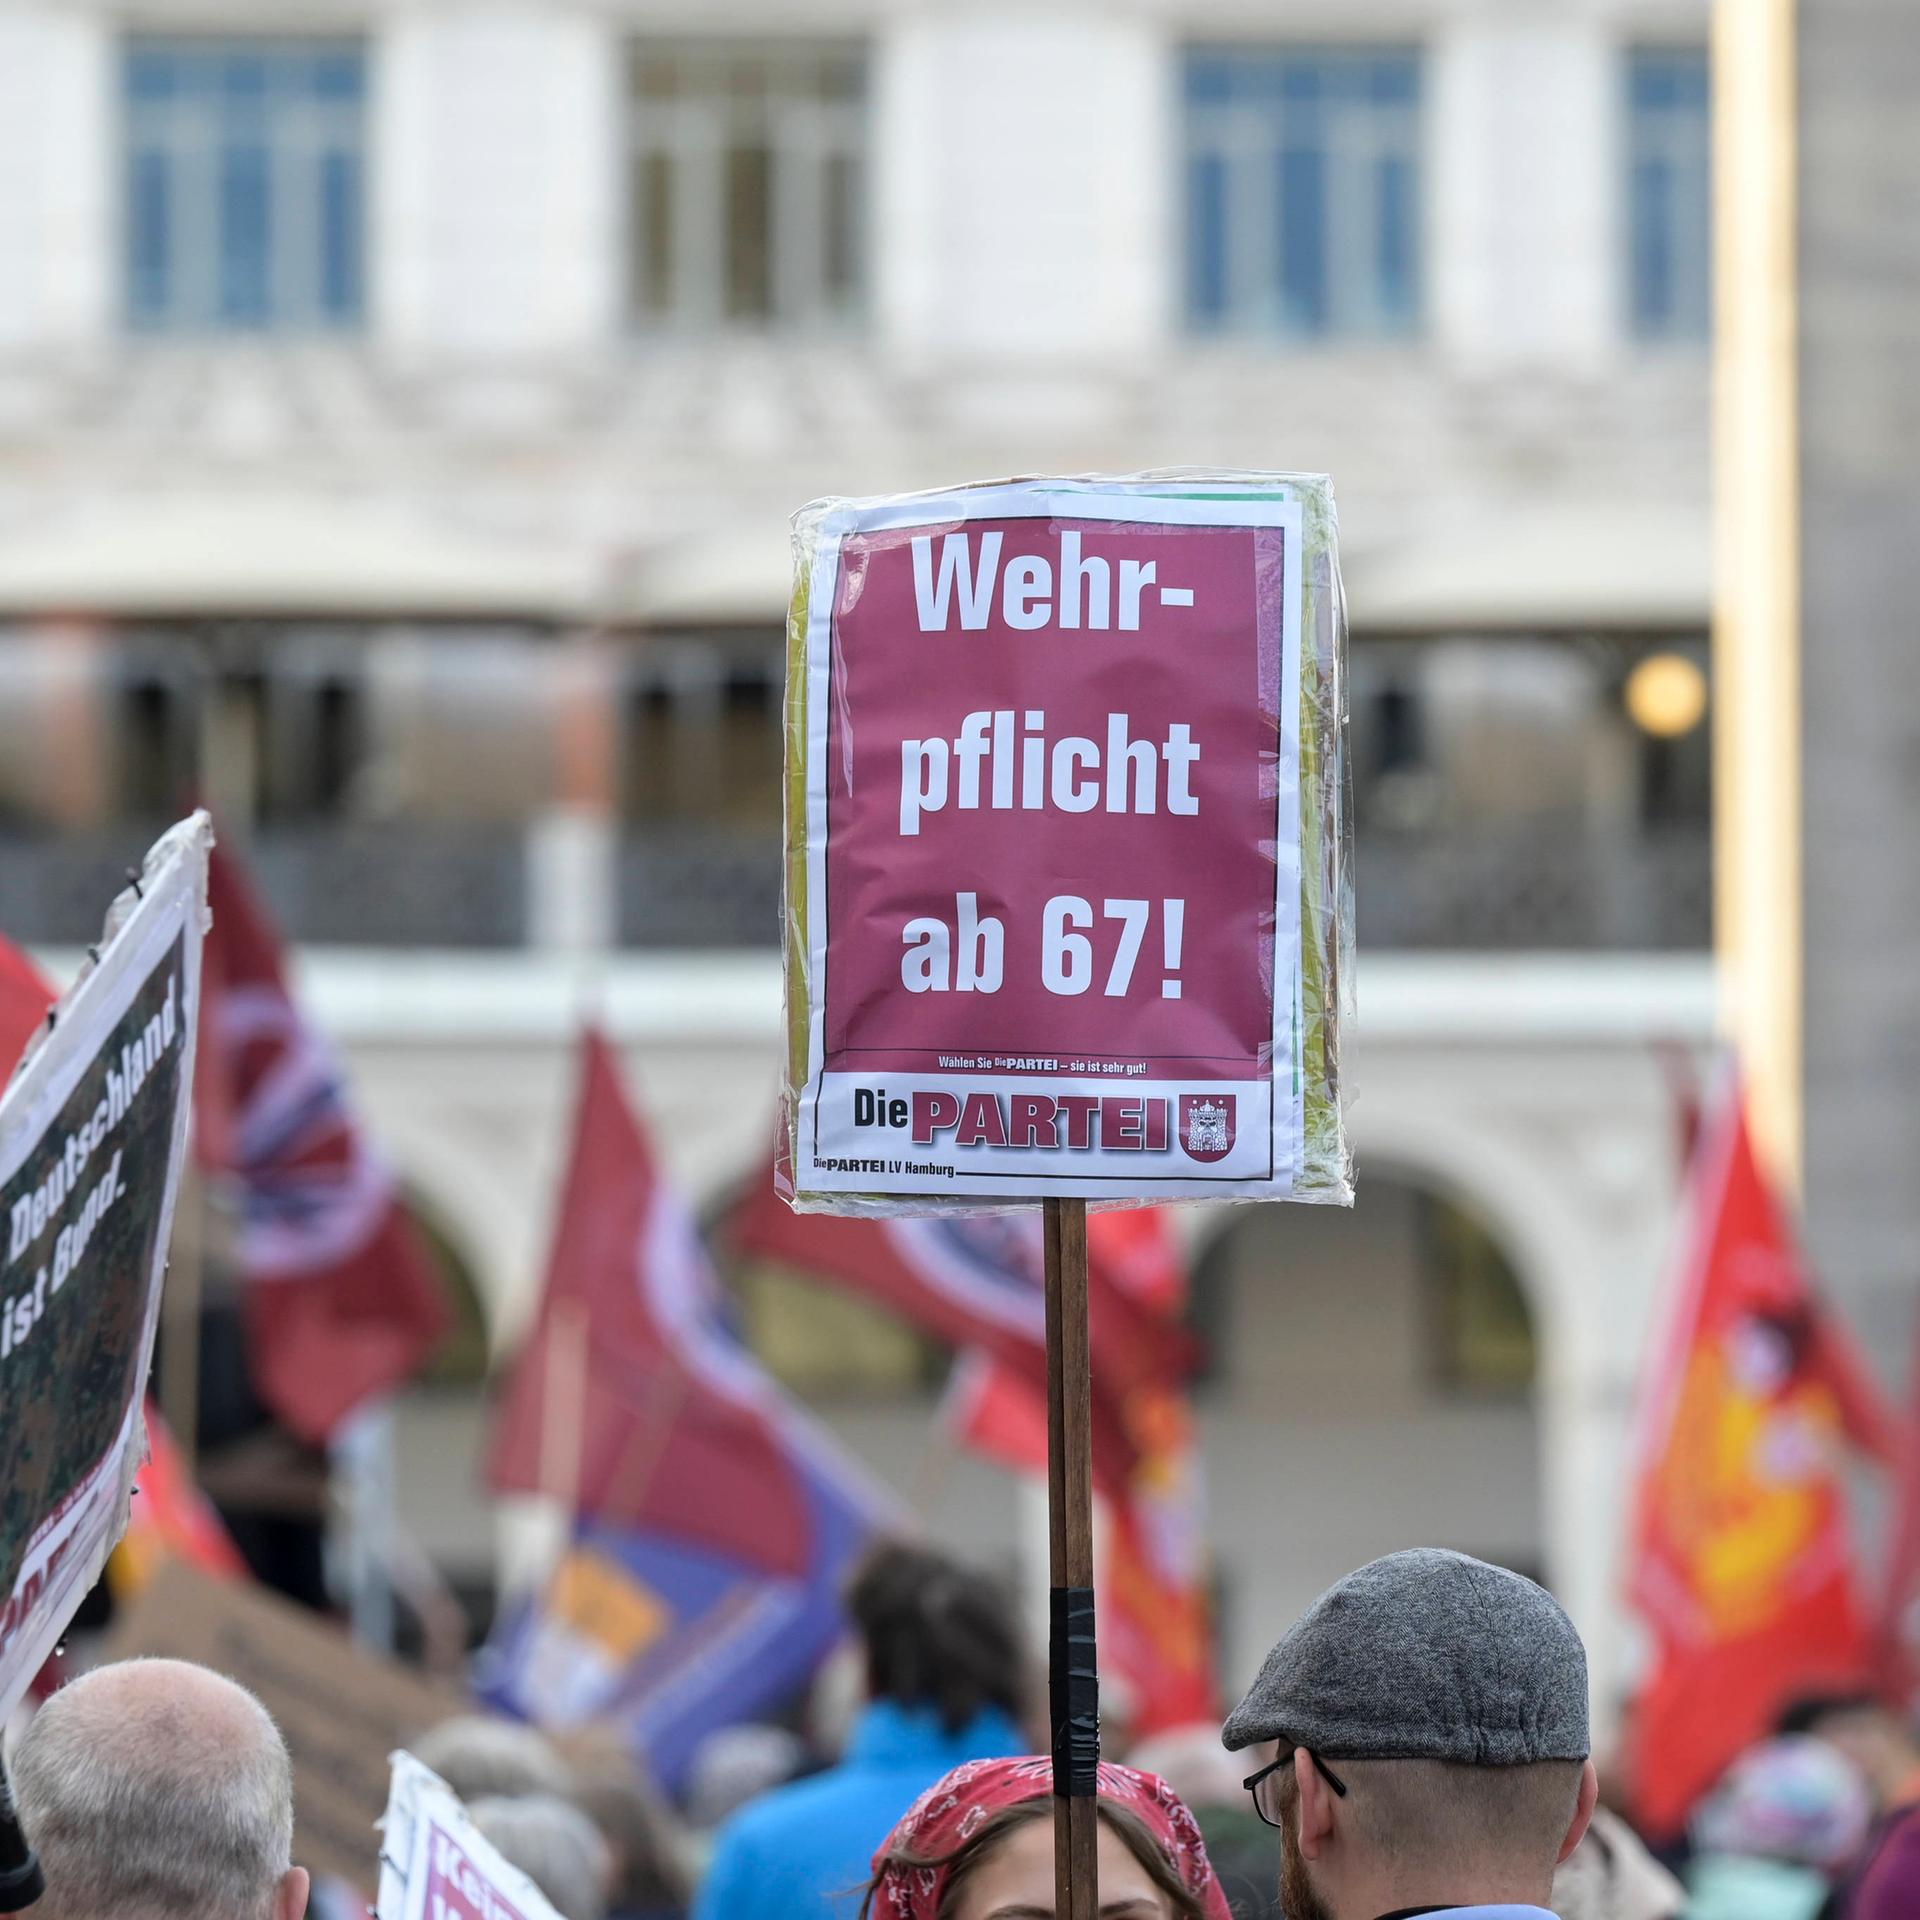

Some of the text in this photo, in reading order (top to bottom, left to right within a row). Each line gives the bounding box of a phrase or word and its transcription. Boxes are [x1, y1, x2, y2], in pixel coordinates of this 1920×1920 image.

[911, 530, 1194, 632] Wehr-
[899, 710, 1200, 836] pflicht
[901, 892, 1185, 1000] ab 67!
[9, 974, 175, 1265] Deutschland
[938, 1055, 976, 1069] Wählen
[977, 1057, 993, 1070] Sie
[1070, 1060, 1085, 1072] sie
[1087, 1060, 1101, 1073] ist
[1102, 1061, 1124, 1074] sehr
[1126, 1063, 1148, 1076] gut!
[888, 1161, 902, 1174] LV
[904, 1161, 955, 1178] Hamburg
[0, 1149, 127, 1360] ist Bund.
